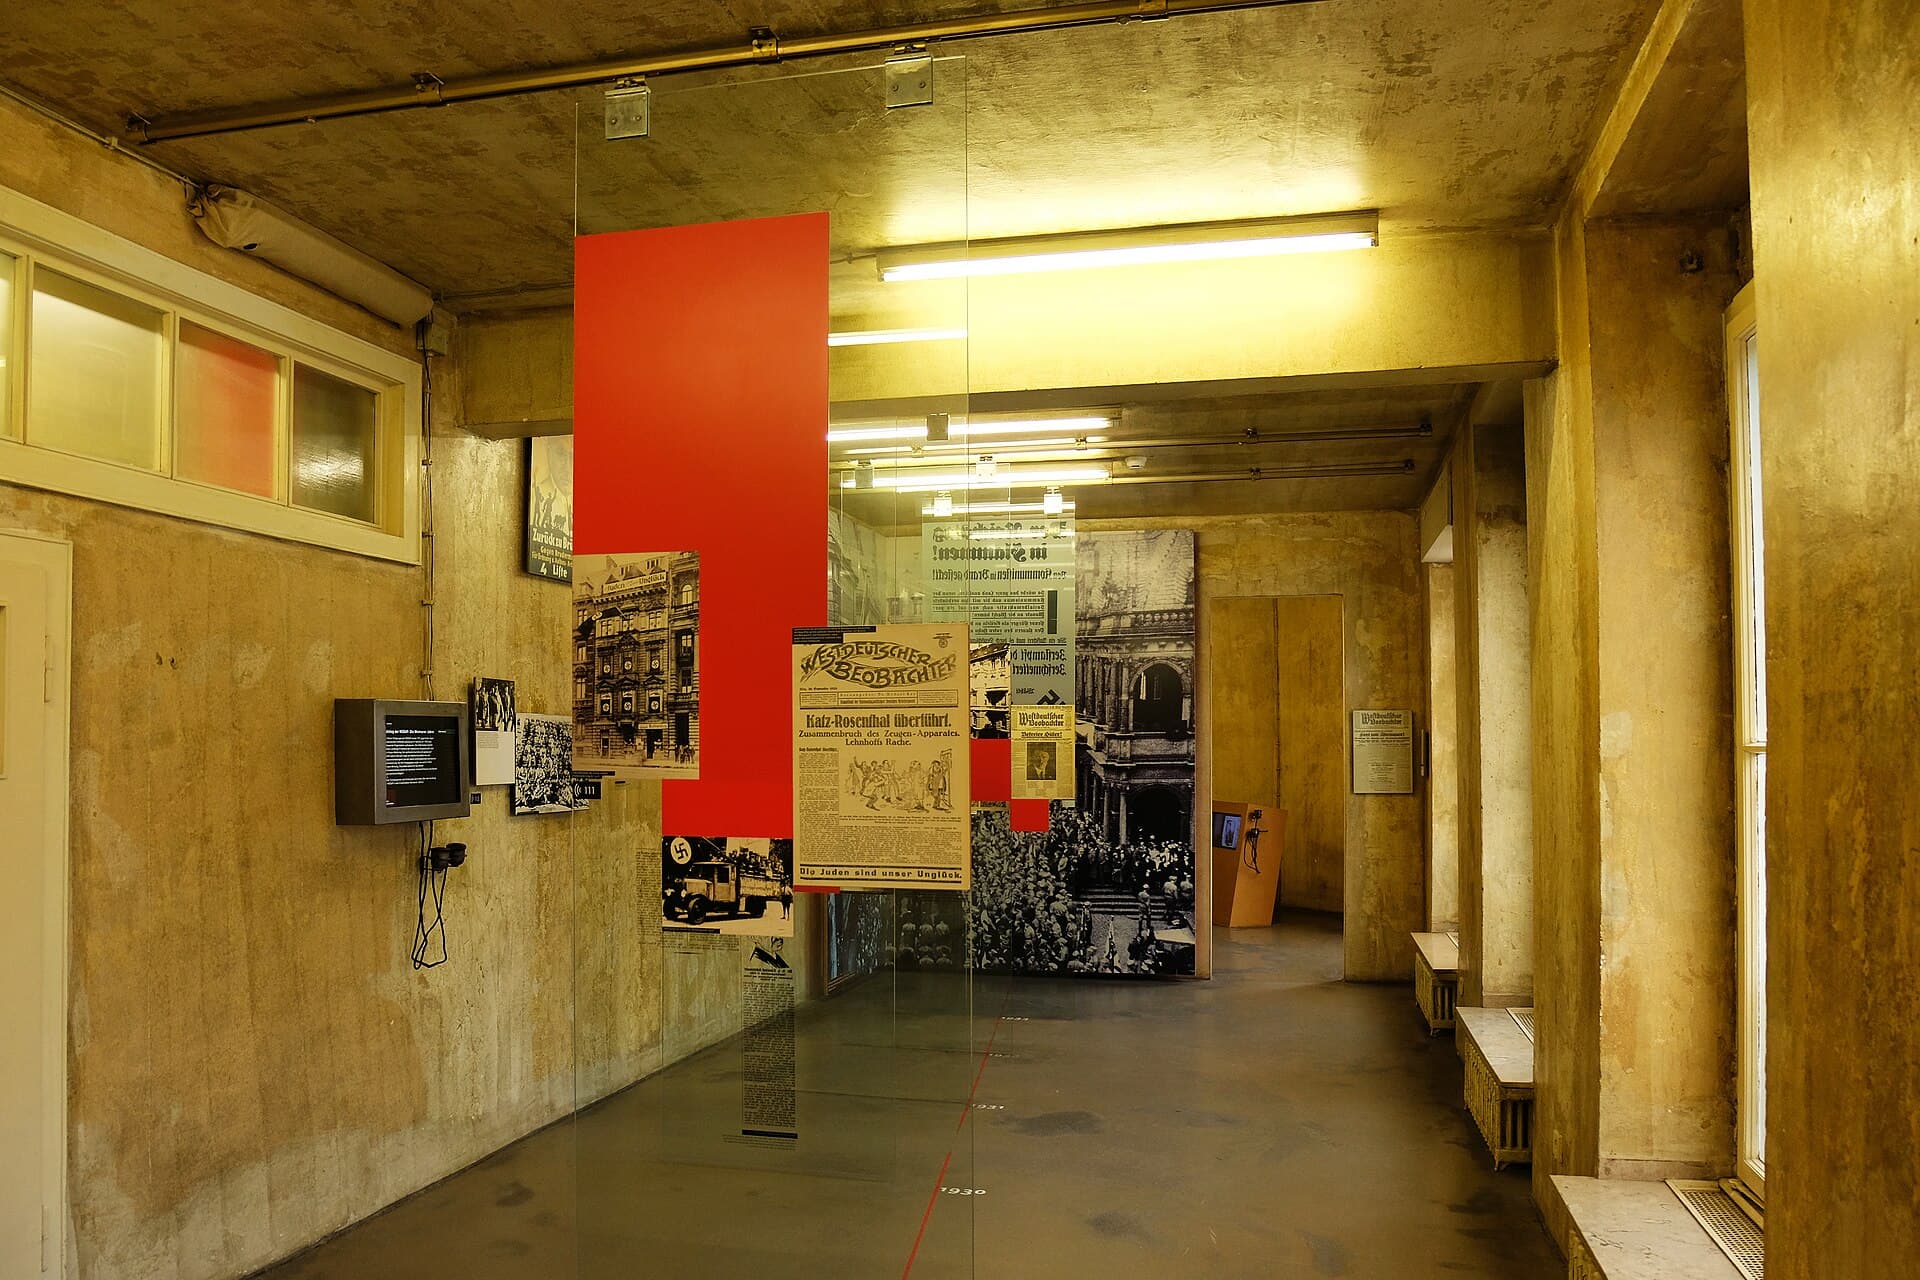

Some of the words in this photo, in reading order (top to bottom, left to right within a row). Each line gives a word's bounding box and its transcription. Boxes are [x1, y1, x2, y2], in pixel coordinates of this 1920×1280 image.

[800, 640, 931, 678] WESTDEUTSCHER
[828, 653, 957, 688] BEOBACHTER
[799, 730, 862, 738] Zusammenbruch
[867, 730, 879, 738] des
[885, 738, 912, 746] Rache.
[820, 868, 849, 876] Juden
[855, 868, 877, 877] sind
[882, 870, 912, 878] unser
[939, 1186, 987, 1196] 1930
